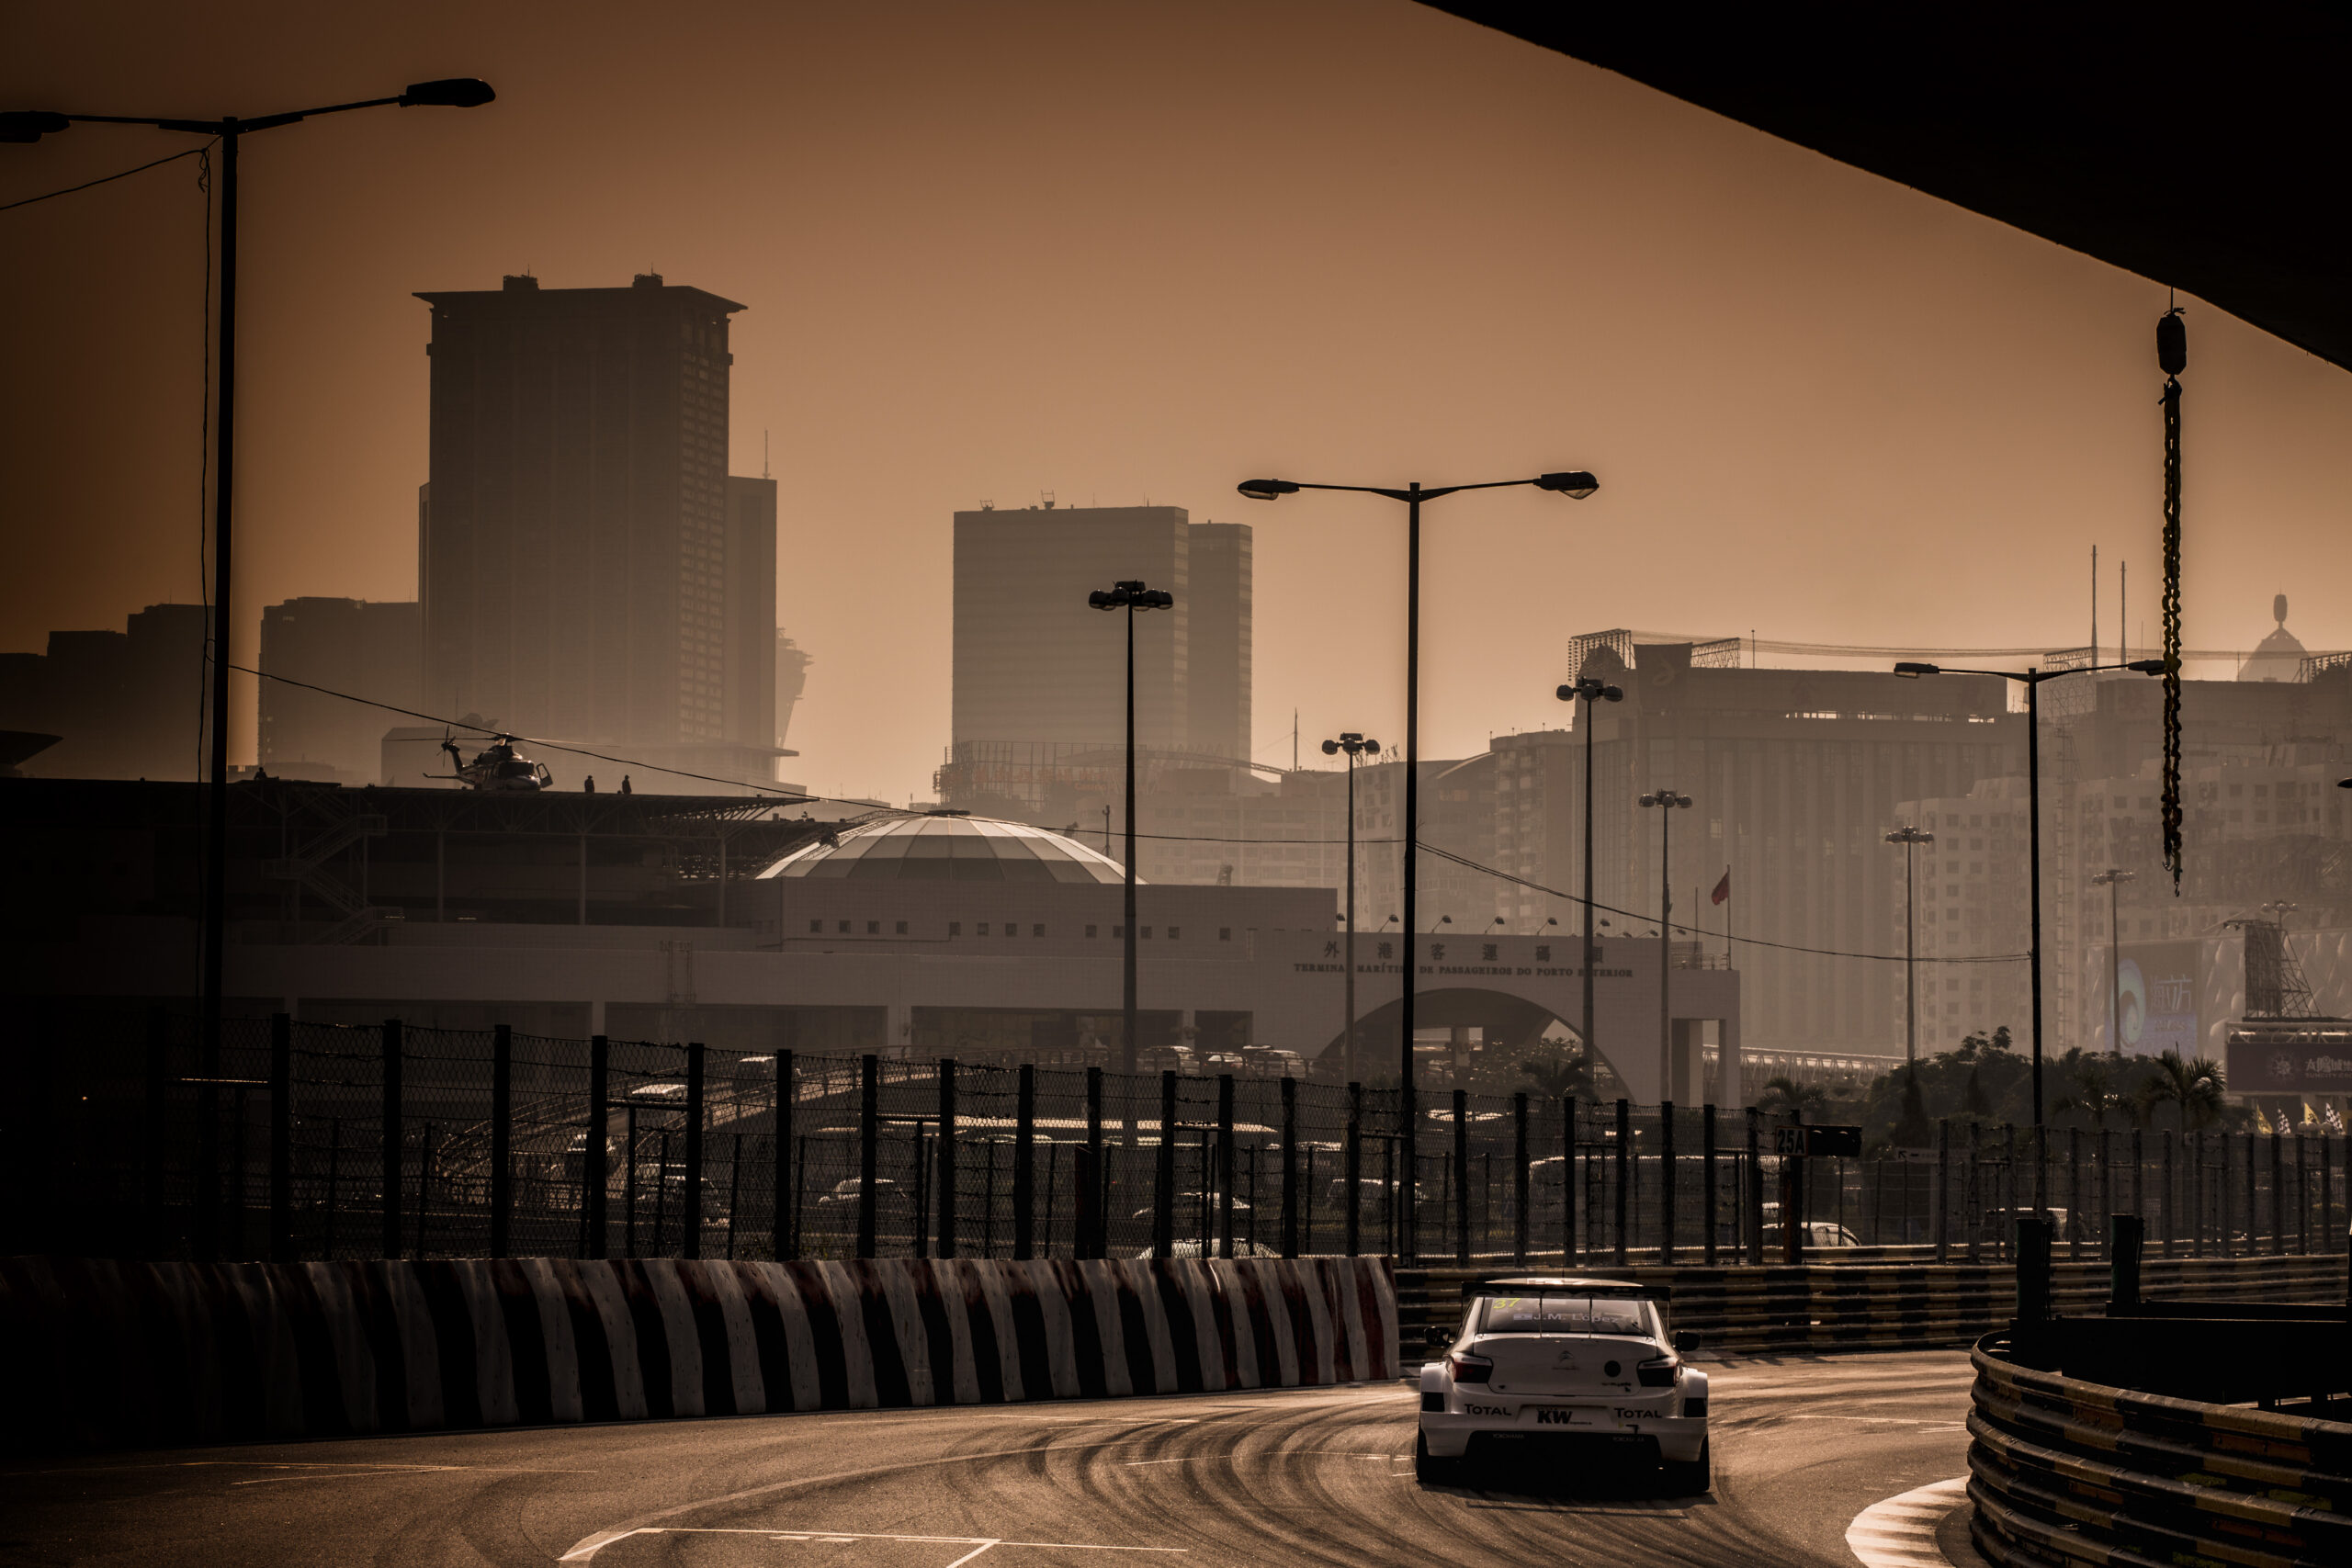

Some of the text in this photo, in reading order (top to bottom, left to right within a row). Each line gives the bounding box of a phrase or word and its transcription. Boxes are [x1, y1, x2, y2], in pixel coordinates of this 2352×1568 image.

[1294, 963, 1632, 977] TERMINA MARÍTI DE PASSAGEIROS DO PORTO ETERIOR
[1777, 1129, 1804, 1154] 25A
[1493, 1297, 1521, 1309] 37
[1532, 1313, 1619, 1324] J.M. López
[1464, 1404, 1512, 1416] TOTAL
[1613, 1407, 1662, 1418] TOTAL
[1537, 1410, 1573, 1424] KW
